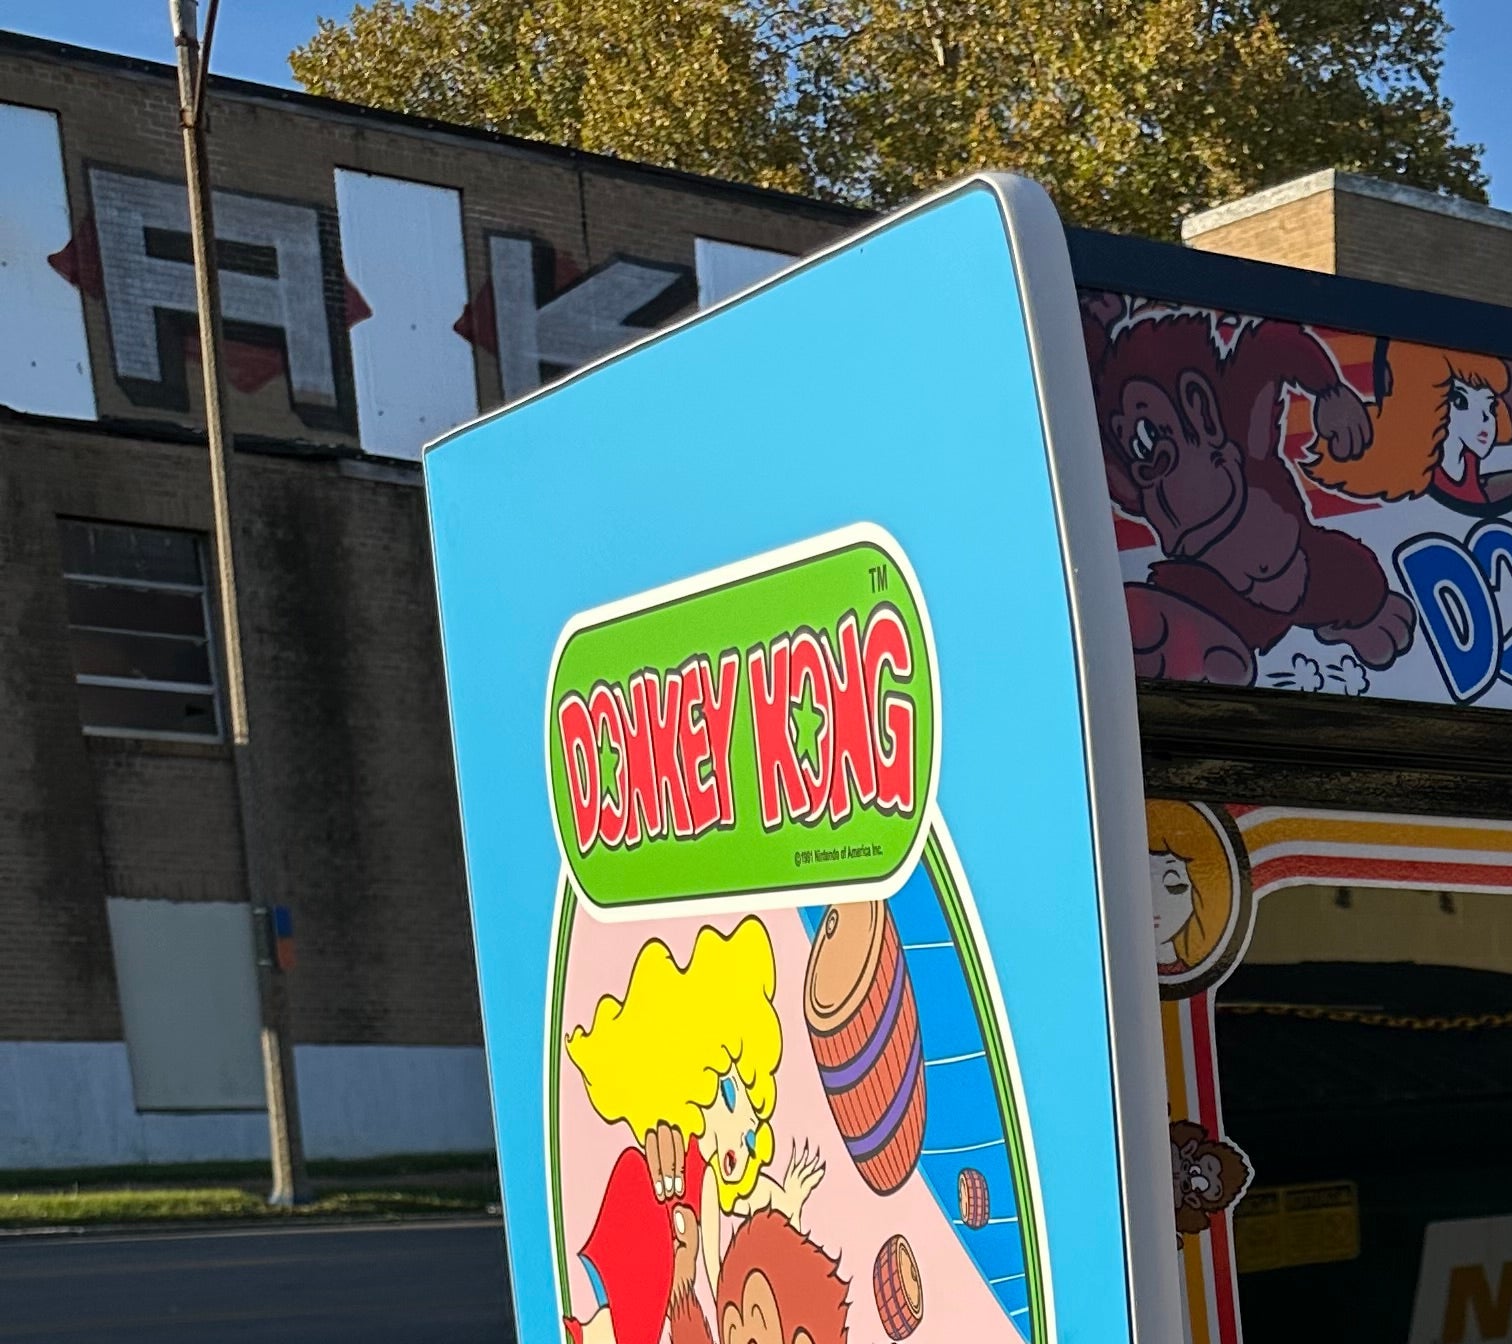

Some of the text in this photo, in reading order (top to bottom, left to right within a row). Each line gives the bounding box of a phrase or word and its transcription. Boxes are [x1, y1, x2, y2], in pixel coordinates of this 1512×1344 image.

[868, 564, 890, 595] TM
[558, 602, 914, 858] DONKEY KONG
[814, 847, 840, 862] Nintendo
[847, 843, 871, 859] America
